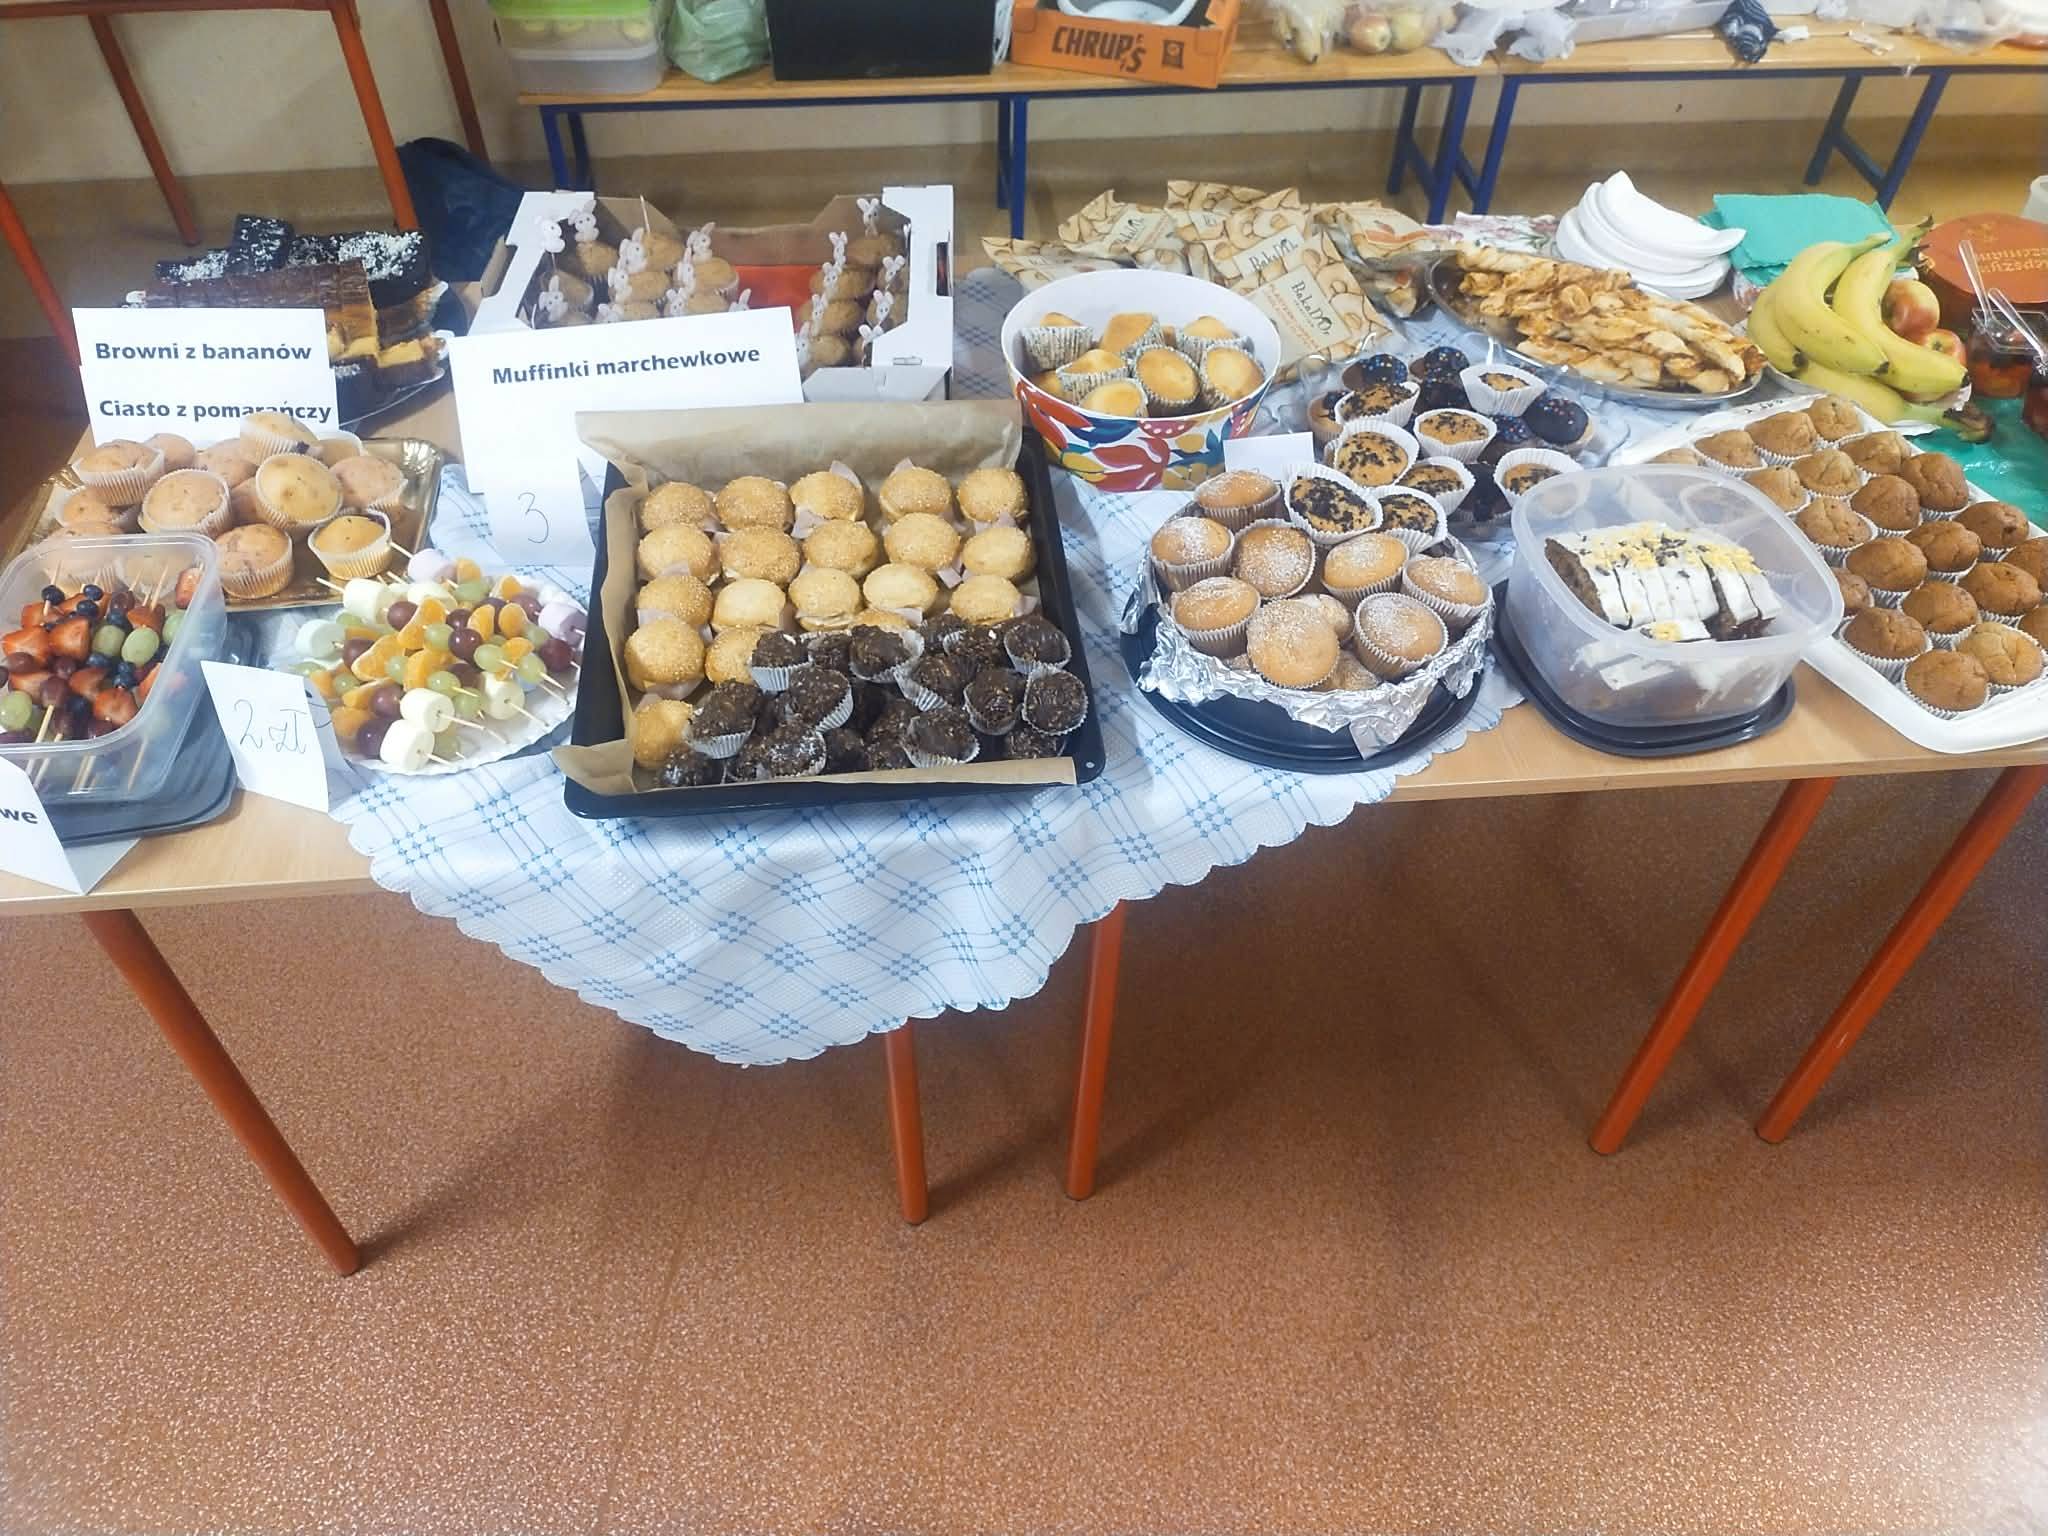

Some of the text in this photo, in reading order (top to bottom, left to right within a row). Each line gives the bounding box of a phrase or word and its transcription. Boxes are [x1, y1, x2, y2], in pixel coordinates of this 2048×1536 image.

[95, 342, 312, 360] Browni z bananów
[493, 349, 761, 384] Muffinki marchewkowe
[99, 400, 170, 417] Ciasto
[176, 403, 187, 417] z
[518, 491, 549, 544] 3
[233, 698, 263, 749] 2
